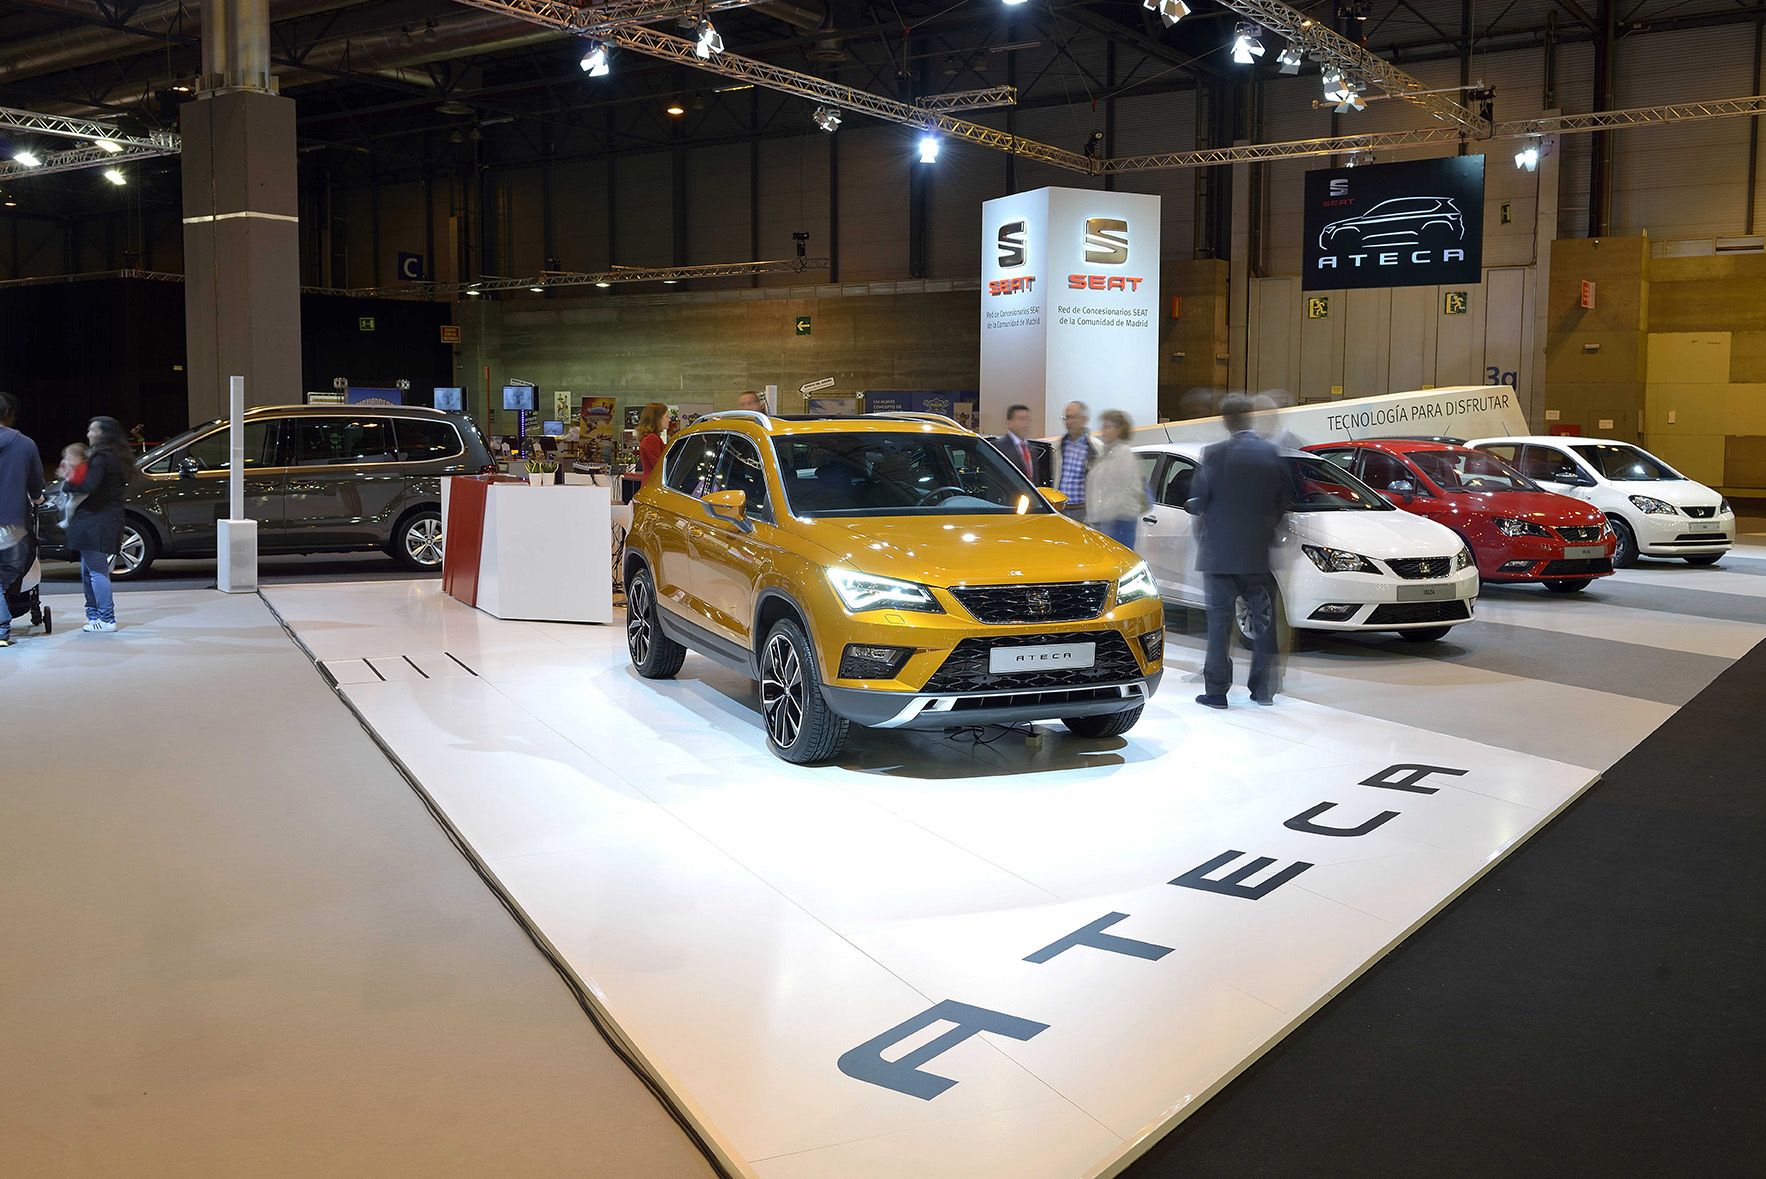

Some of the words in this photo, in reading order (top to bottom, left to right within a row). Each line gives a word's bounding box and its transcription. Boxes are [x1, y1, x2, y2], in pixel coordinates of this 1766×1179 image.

[1322, 198, 1355, 208] SEAT
[1317, 248, 1465, 270] ATECA
[403, 257, 418, 278] C
[988, 276, 1034, 295] SEAT
[1068, 274, 1144, 292] SEAT
[1000, 307, 1029, 317] Concesionarios
[1029, 305, 1040, 315] SEAT
[1057, 305, 1070, 314] Red
[1072, 305, 1081, 314] de
[1082, 306, 1132, 317] Concesionarios
[1133, 308, 1149, 317] SEAT
[996, 318, 1020, 329] Comunidad
[1025, 316, 1041, 326] Madrid
[1059, 316, 1068, 325] de
[1070, 316, 1076, 325] la
[1077, 317, 1115, 327] Comunidad
[1116, 318, 1125, 327] de
[1125, 319, 1149, 328] Madrid
[1327, 404, 1409, 431] TECNOLOGÍA
[1411, 403, 1443, 421] PARA
[1446, 394, 1510, 416] DISFRUTAR
[1016, 652, 1072, 662] ATECA
[837, 763, 1470, 1101] ATECA
